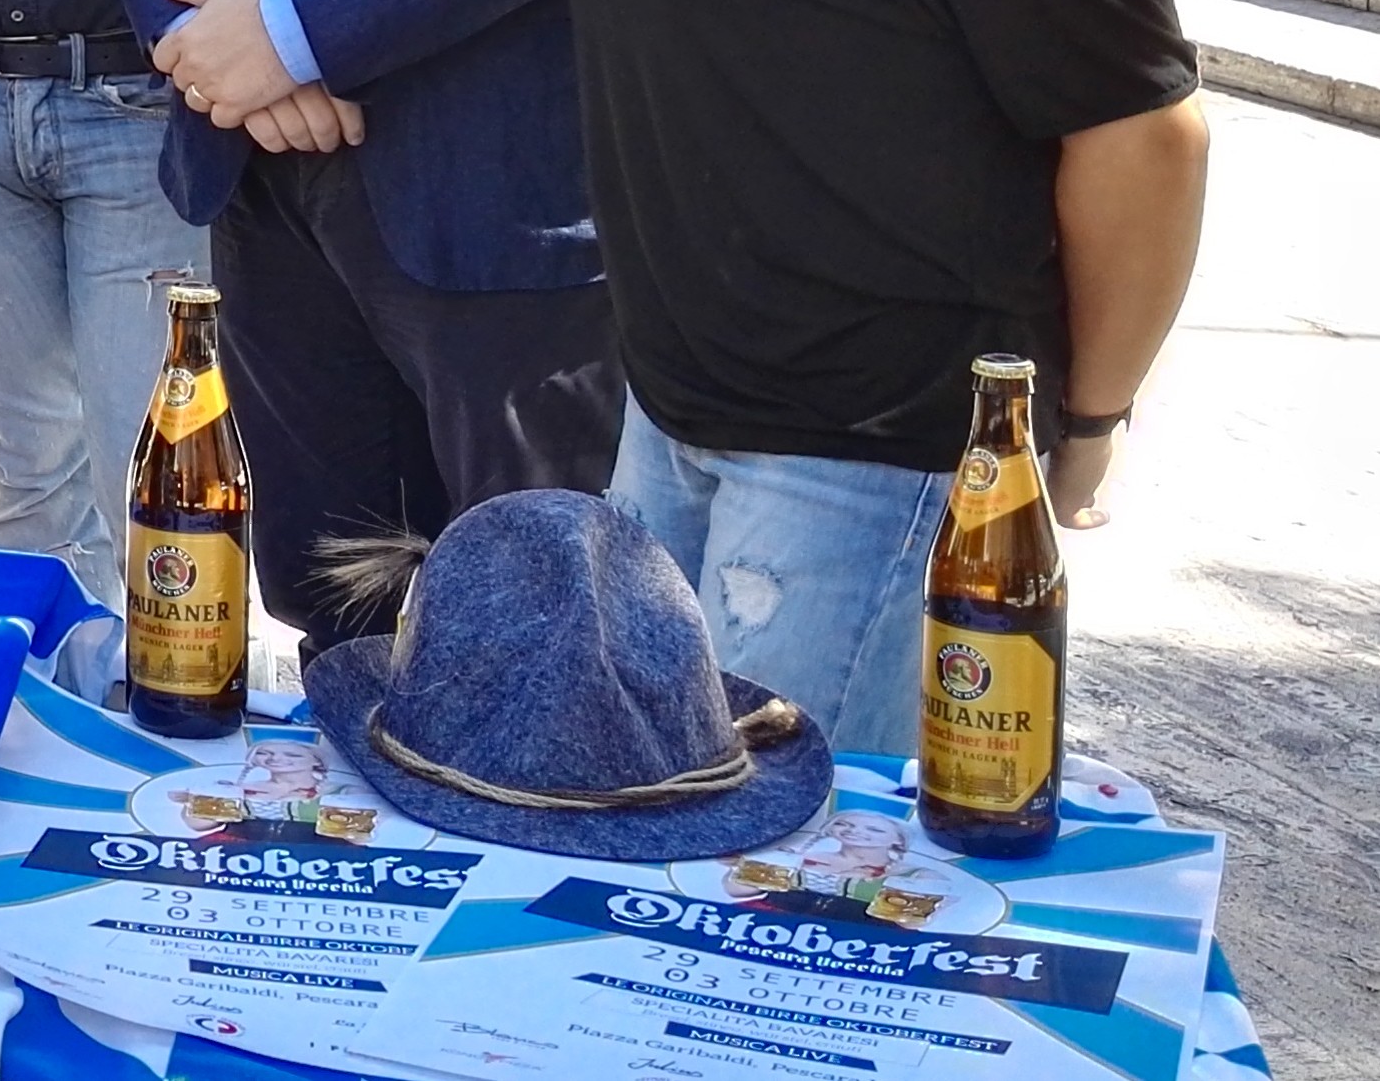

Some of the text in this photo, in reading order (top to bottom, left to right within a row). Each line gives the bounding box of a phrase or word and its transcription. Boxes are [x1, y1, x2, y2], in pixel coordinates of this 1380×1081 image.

[127, 587, 231, 623] PAULANER
[173, 641, 204, 652] LAGER
[194, 627, 223, 640] Hell
[923, 695, 1033, 733] AULANER
[962, 749, 998, 764] LAGER
[987, 737, 1020, 752] Hell
[204, 871, 374, 895] Pescara Vecchia
[141, 886, 431, 924] 29 SETTEMBRE
[165, 905, 404, 939] 03 OTTOBRE
[115, 921, 417, 956] LE ORIGINALI BIRRE OKTOBE
[606, 887, 1044, 983] Oktoberfest
[274, 950, 380, 967] BAVARESI
[720, 938, 905, 978] Pescara Vecchia
[104, 963, 172, 983] Piazza
[295, 991, 380, 1010] Pescara
[212, 964, 355, 989] MUSICA LIVE
[642, 945, 958, 1009] 29 SETTEMBRE
[663, 967, 920, 1022] 03 OTTOBRE
[601, 976, 999, 1052] LE ORIGINALI BIRRE OKTOBERFEST
[567, 1023, 639, 1046] Piazza
[689, 1028, 842, 1065] MUSICA LIVE
[767, 1022, 879, 1047] BAVARESI
